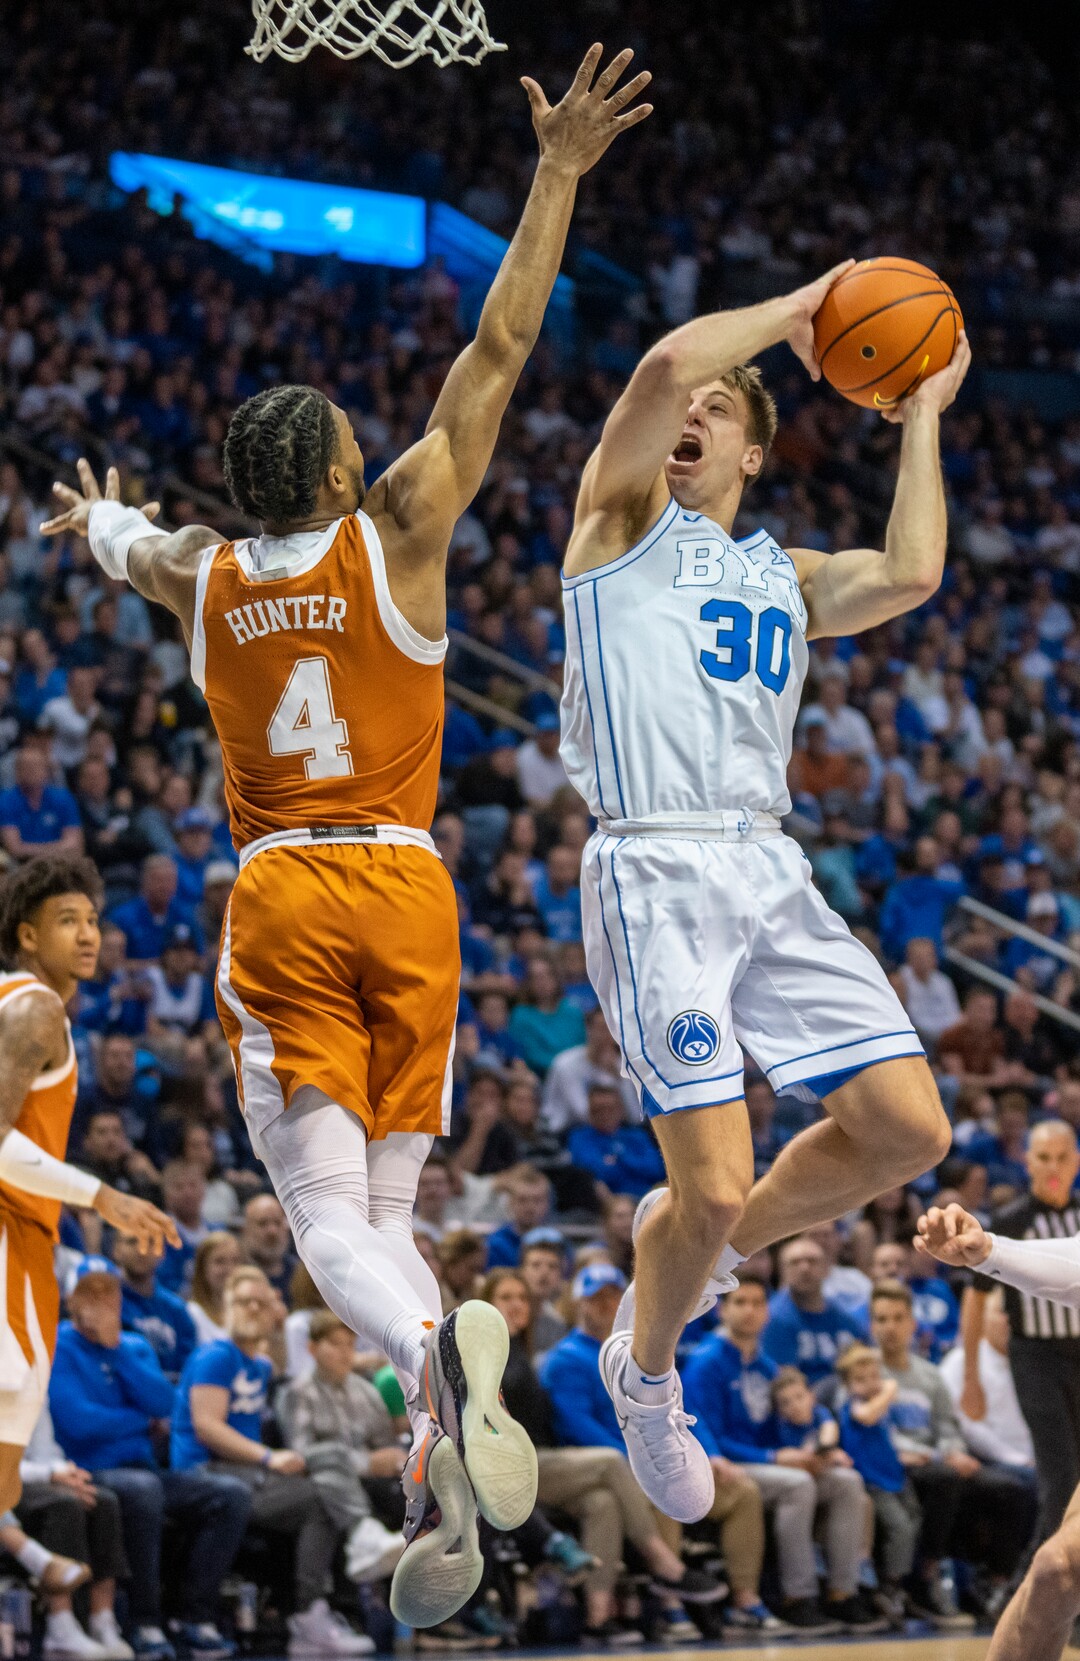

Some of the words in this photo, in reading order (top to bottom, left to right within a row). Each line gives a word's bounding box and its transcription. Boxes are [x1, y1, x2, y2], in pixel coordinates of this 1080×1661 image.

[224, 595, 347, 645] HUNTER
[700, 598, 792, 696] 30
[267, 656, 354, 780] 4
[687, 1042, 705, 1056] Y
